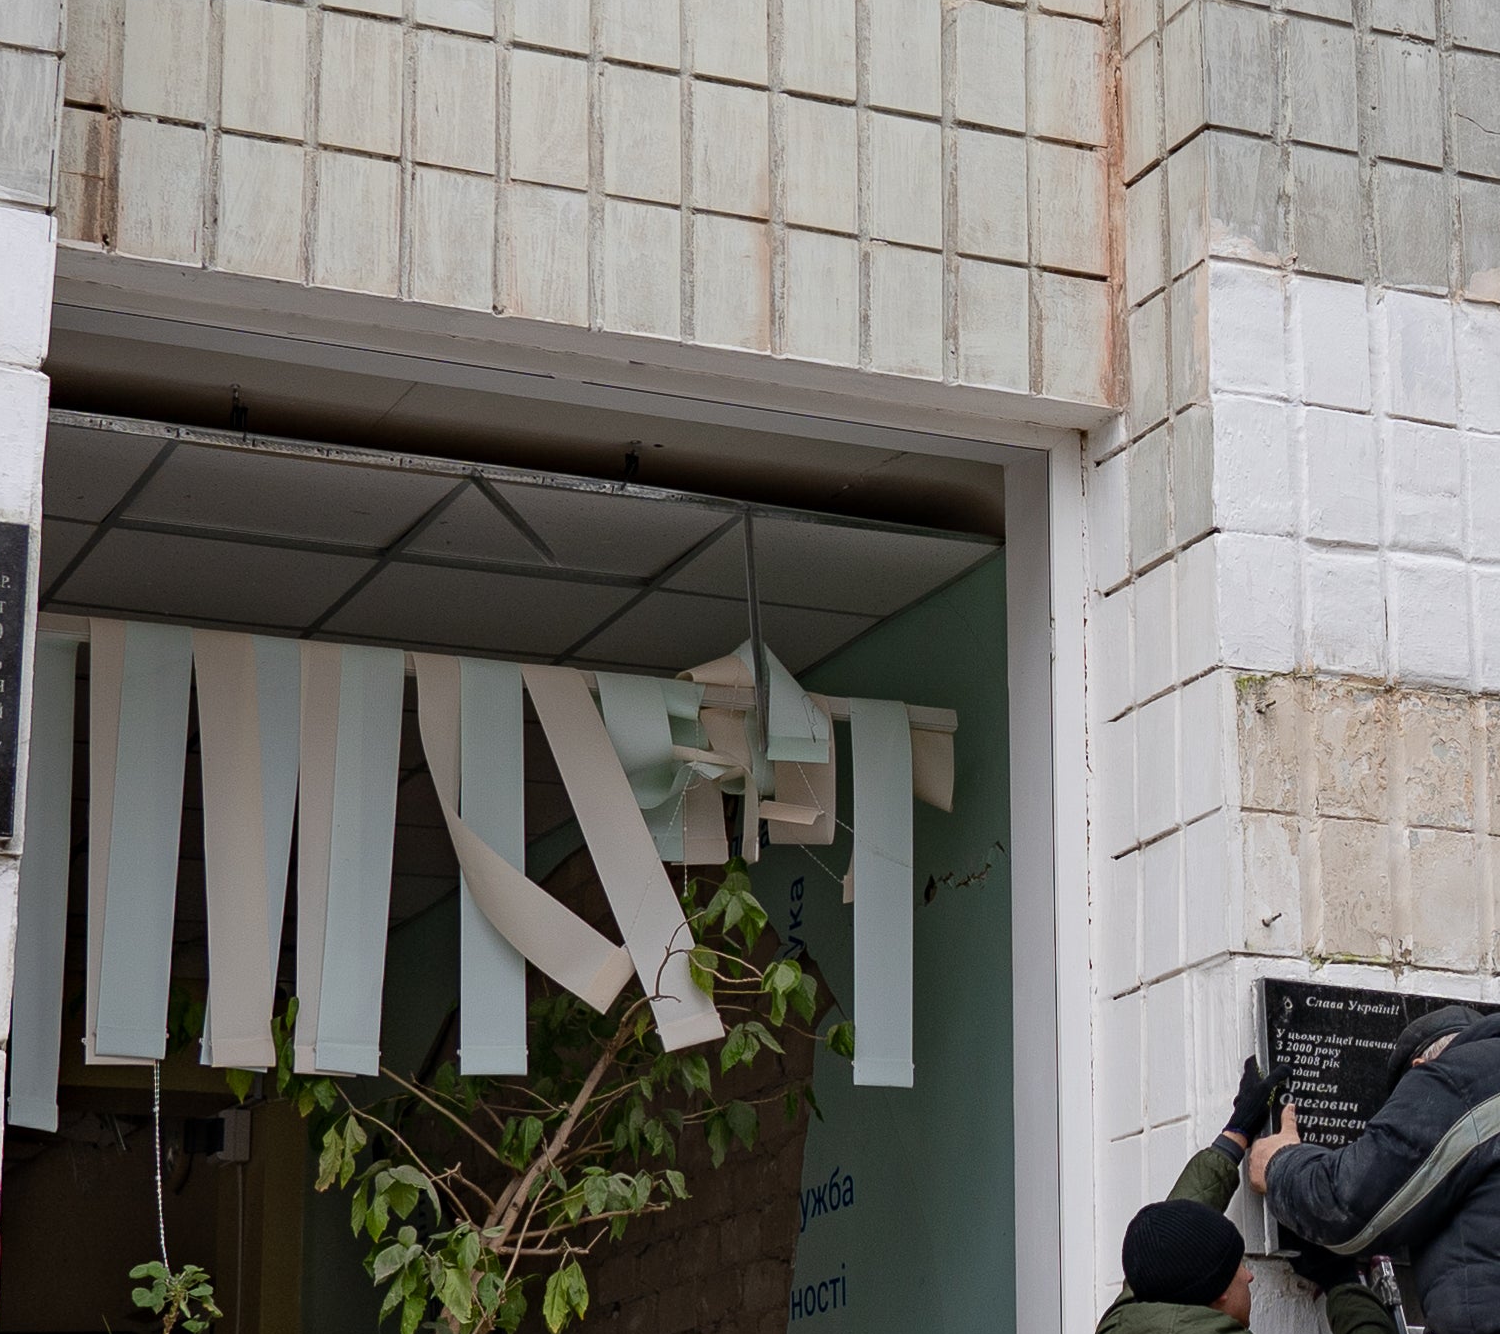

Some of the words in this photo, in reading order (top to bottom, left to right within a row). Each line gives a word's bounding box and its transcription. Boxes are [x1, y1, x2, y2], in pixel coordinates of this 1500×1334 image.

[1306, 996, 1343, 1010] Слава
[1348, 1000, 1399, 1016] Україні!
[1276, 1028, 1285, 1039] У
[1288, 1031, 1323, 1044] цьому
[1324, 1033, 1352, 1046] ліцеї
[1286, 1041, 1312, 1053] 2000
[1314, 1046, 1341, 1057] року
[1276, 1054, 1291, 1063] по
[1293, 1055, 1320, 1066] 2008
[1322, 1058, 1340, 1069] рік
[1279, 1093, 1358, 1112] Олегович
[1302, 1132, 1345, 1145] 10.1993
